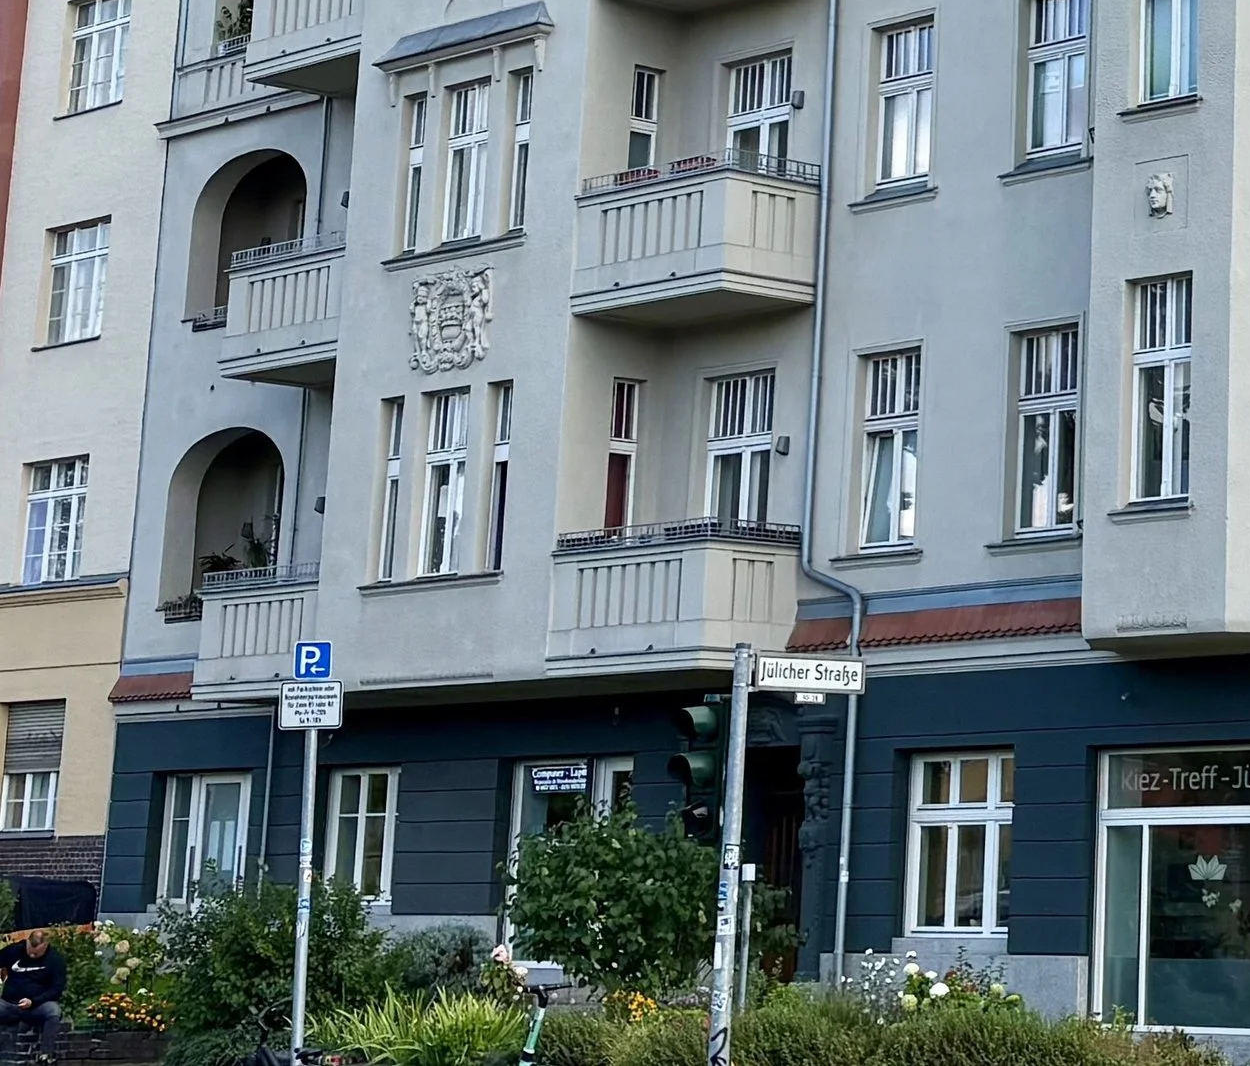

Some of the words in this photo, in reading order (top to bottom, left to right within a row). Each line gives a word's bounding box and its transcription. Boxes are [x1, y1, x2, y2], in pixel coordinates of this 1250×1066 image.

[300, 646, 321, 675] P
[761, 661, 810, 682] Jülicher
[815, 663, 858, 686] Straße
